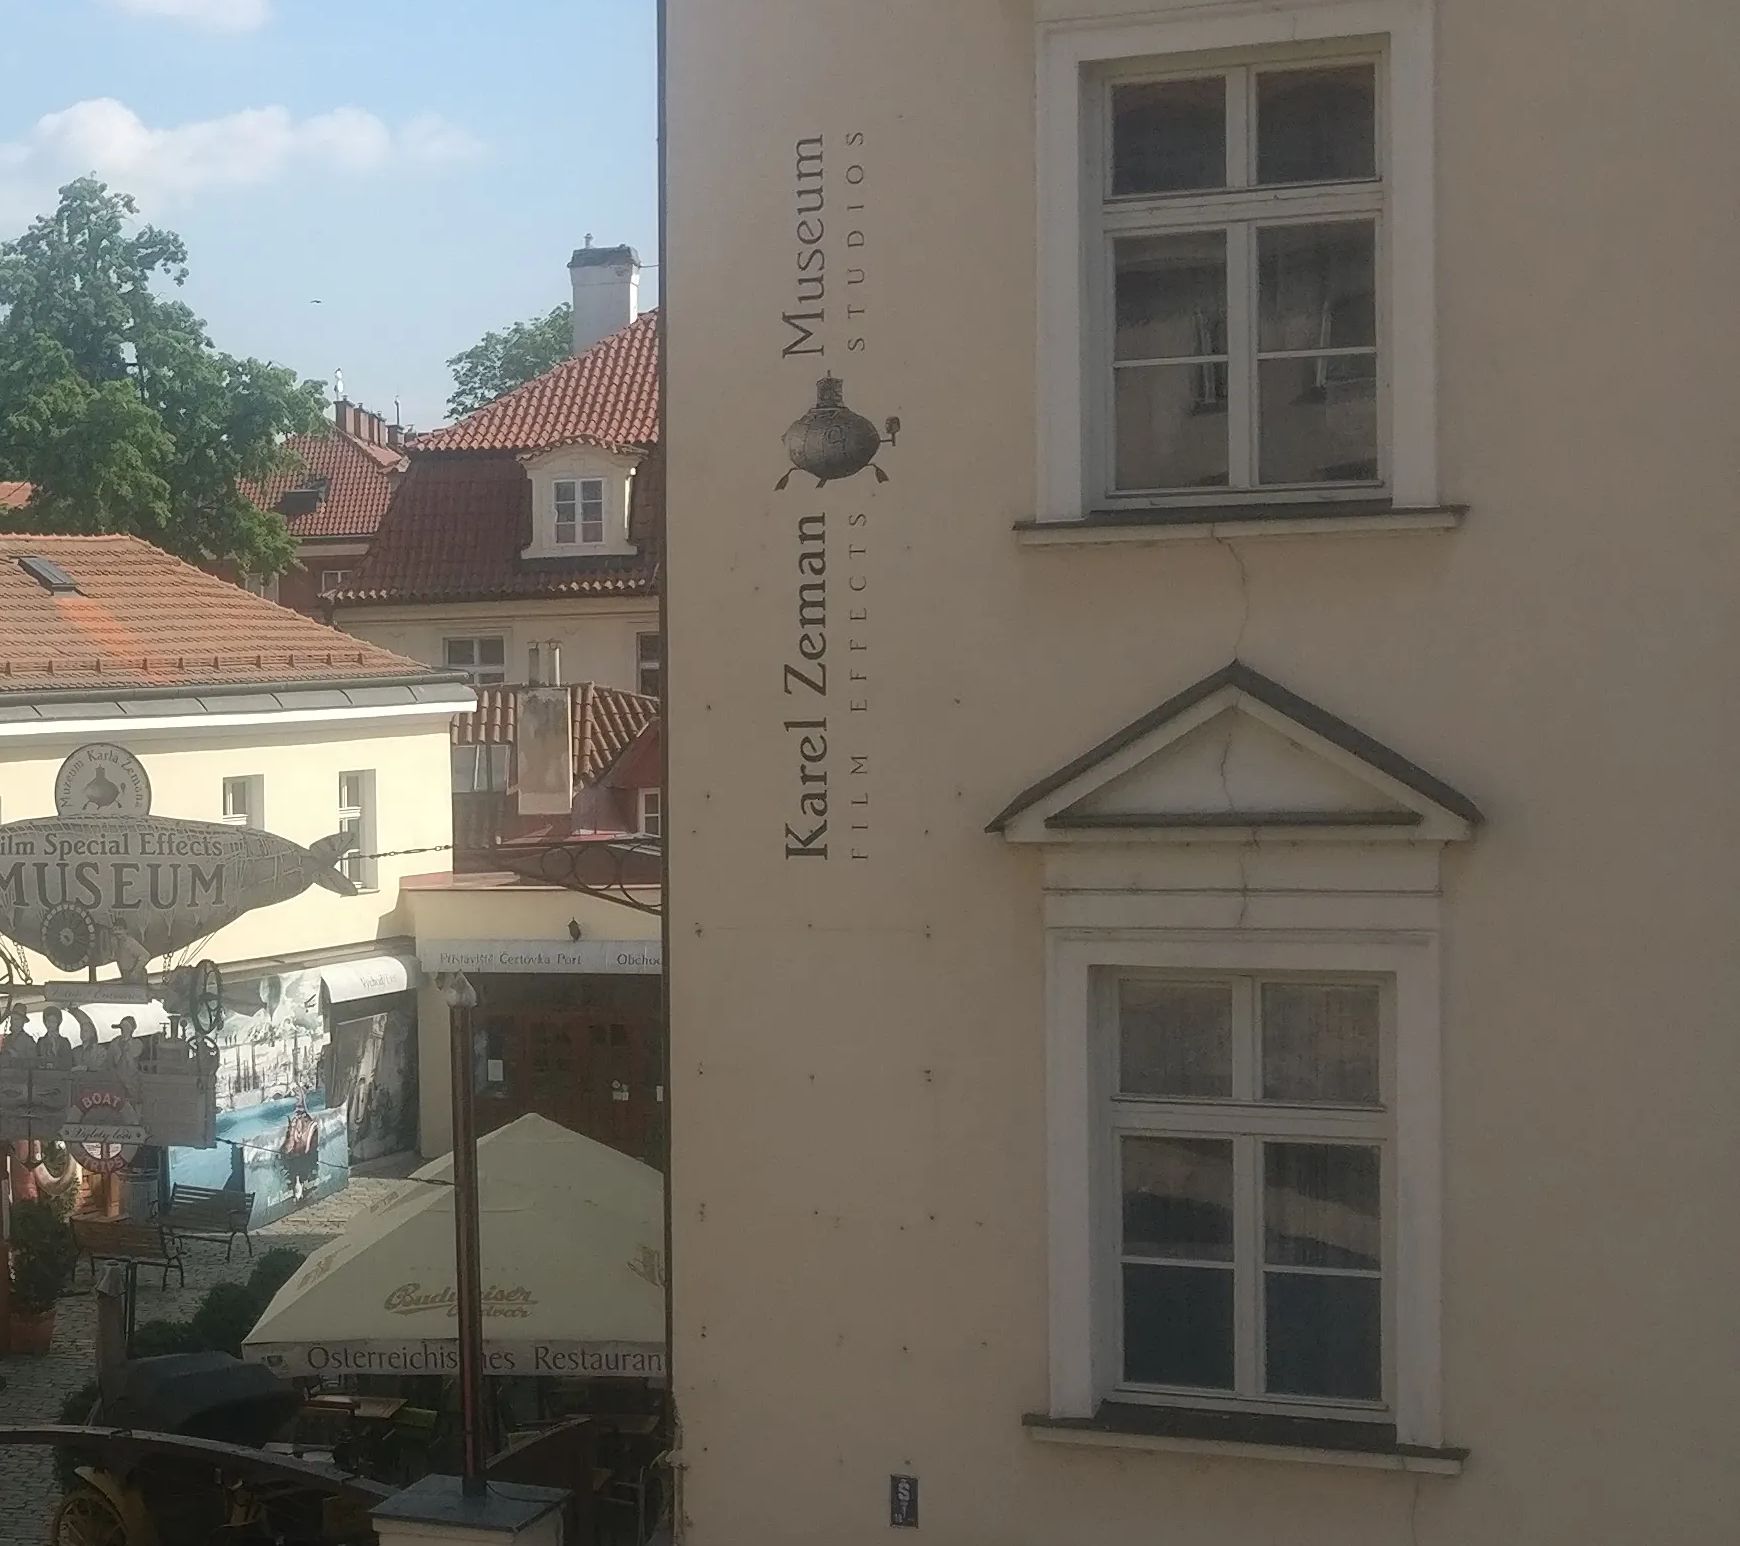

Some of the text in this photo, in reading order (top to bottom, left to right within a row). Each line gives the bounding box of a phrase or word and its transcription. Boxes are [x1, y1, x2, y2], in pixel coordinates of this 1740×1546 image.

[782, 134, 828, 860] Karel Zeman Museum
[845, 131, 868, 861] FILM EFFECTS STUDIOS
[60, 749, 143, 808] Muzeum Karla Zemana
[43, 833, 130, 860] Special
[140, 833, 223, 857] Effects
[81, 1092, 122, 1109] BOAT
[83, 1156, 124, 1172] TRIPS
[535, 1345, 663, 1372] Restauran
